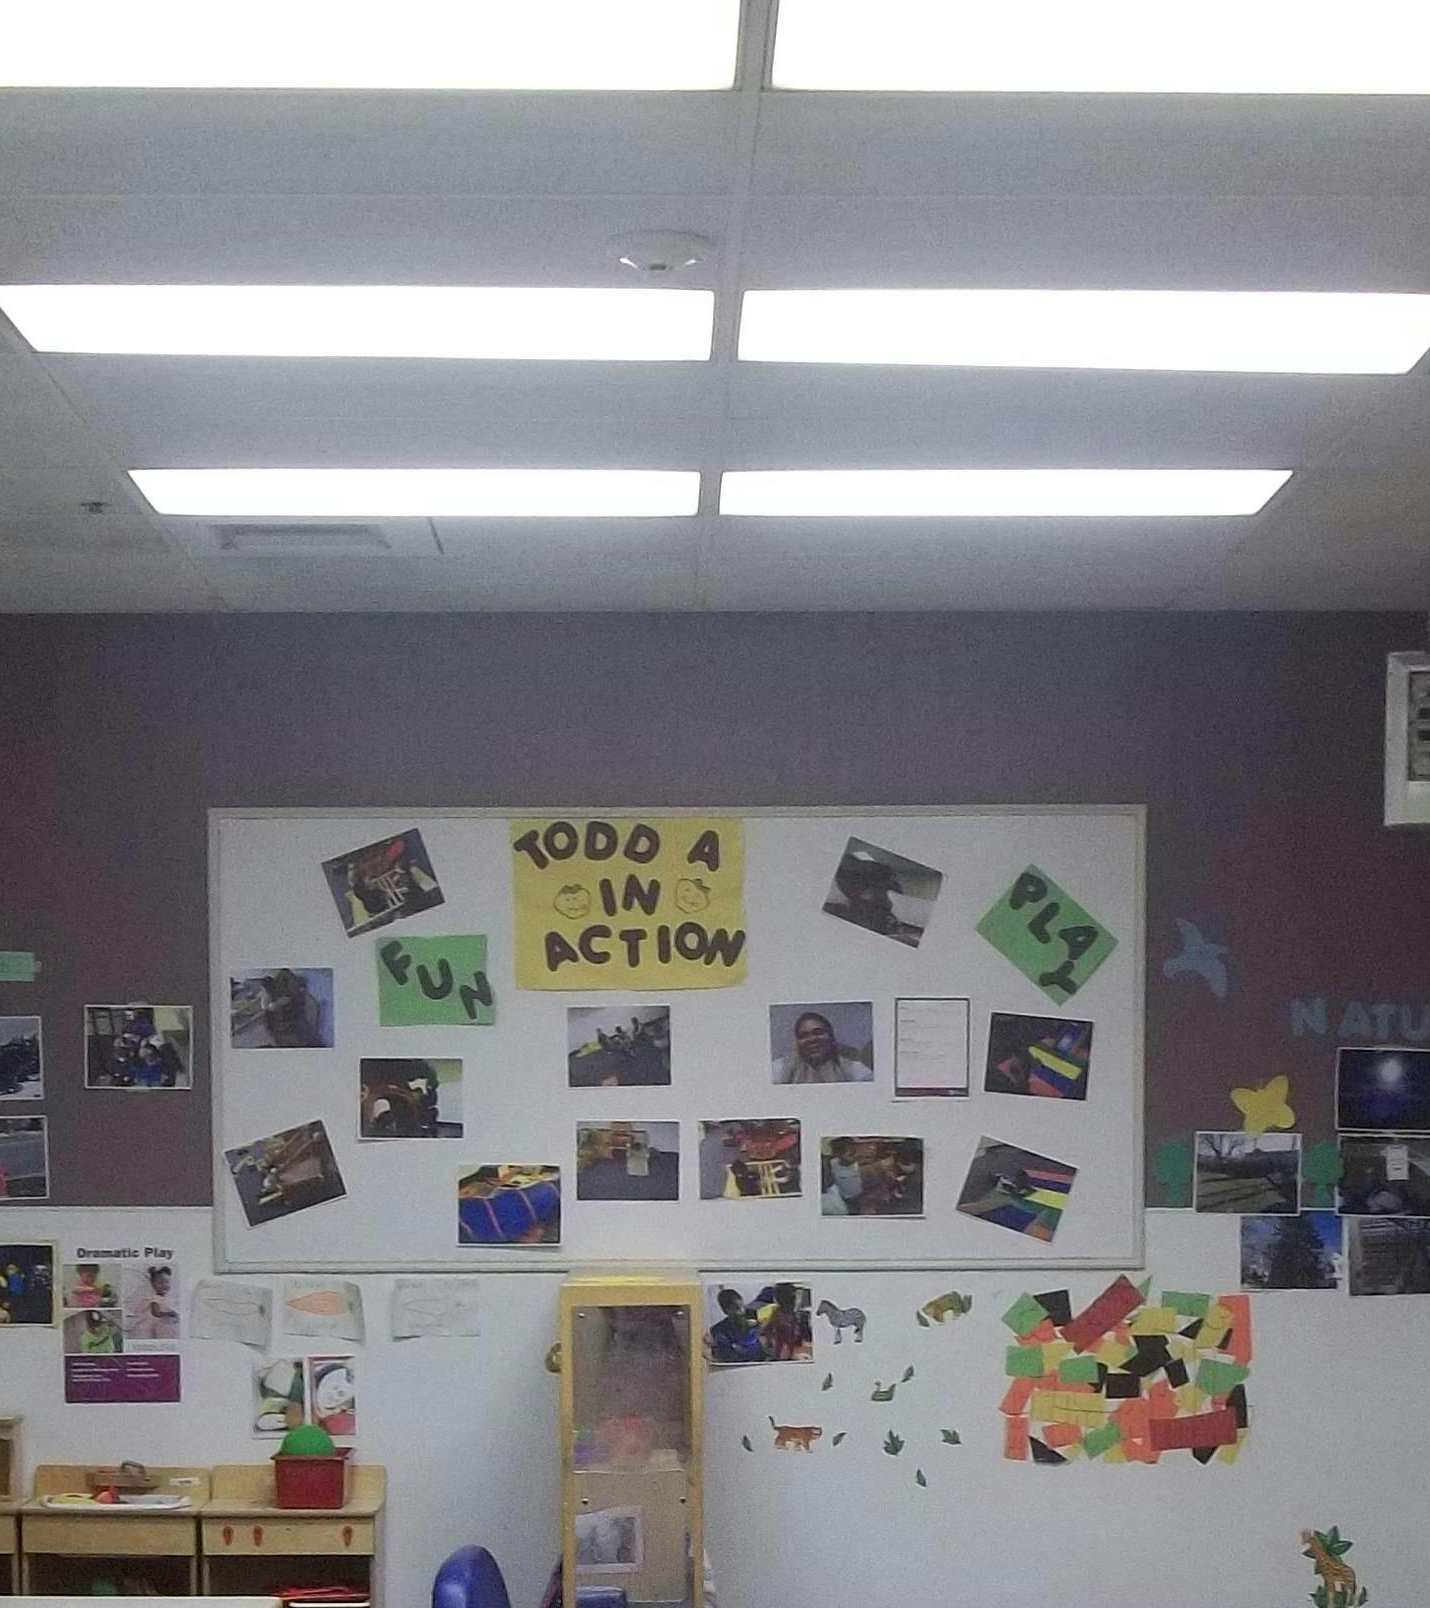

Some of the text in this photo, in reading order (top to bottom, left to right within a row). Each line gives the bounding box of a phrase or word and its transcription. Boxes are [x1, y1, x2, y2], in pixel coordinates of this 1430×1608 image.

[513, 821, 720, 872] TODD A
[599, 874, 661, 917] IN
[544, 922, 746, 972] ACTION
[1009, 872, 1098, 995] PLAY
[380, 940, 493, 1020] FUN
[77, 1247, 174, 1260] Dramatic Play
